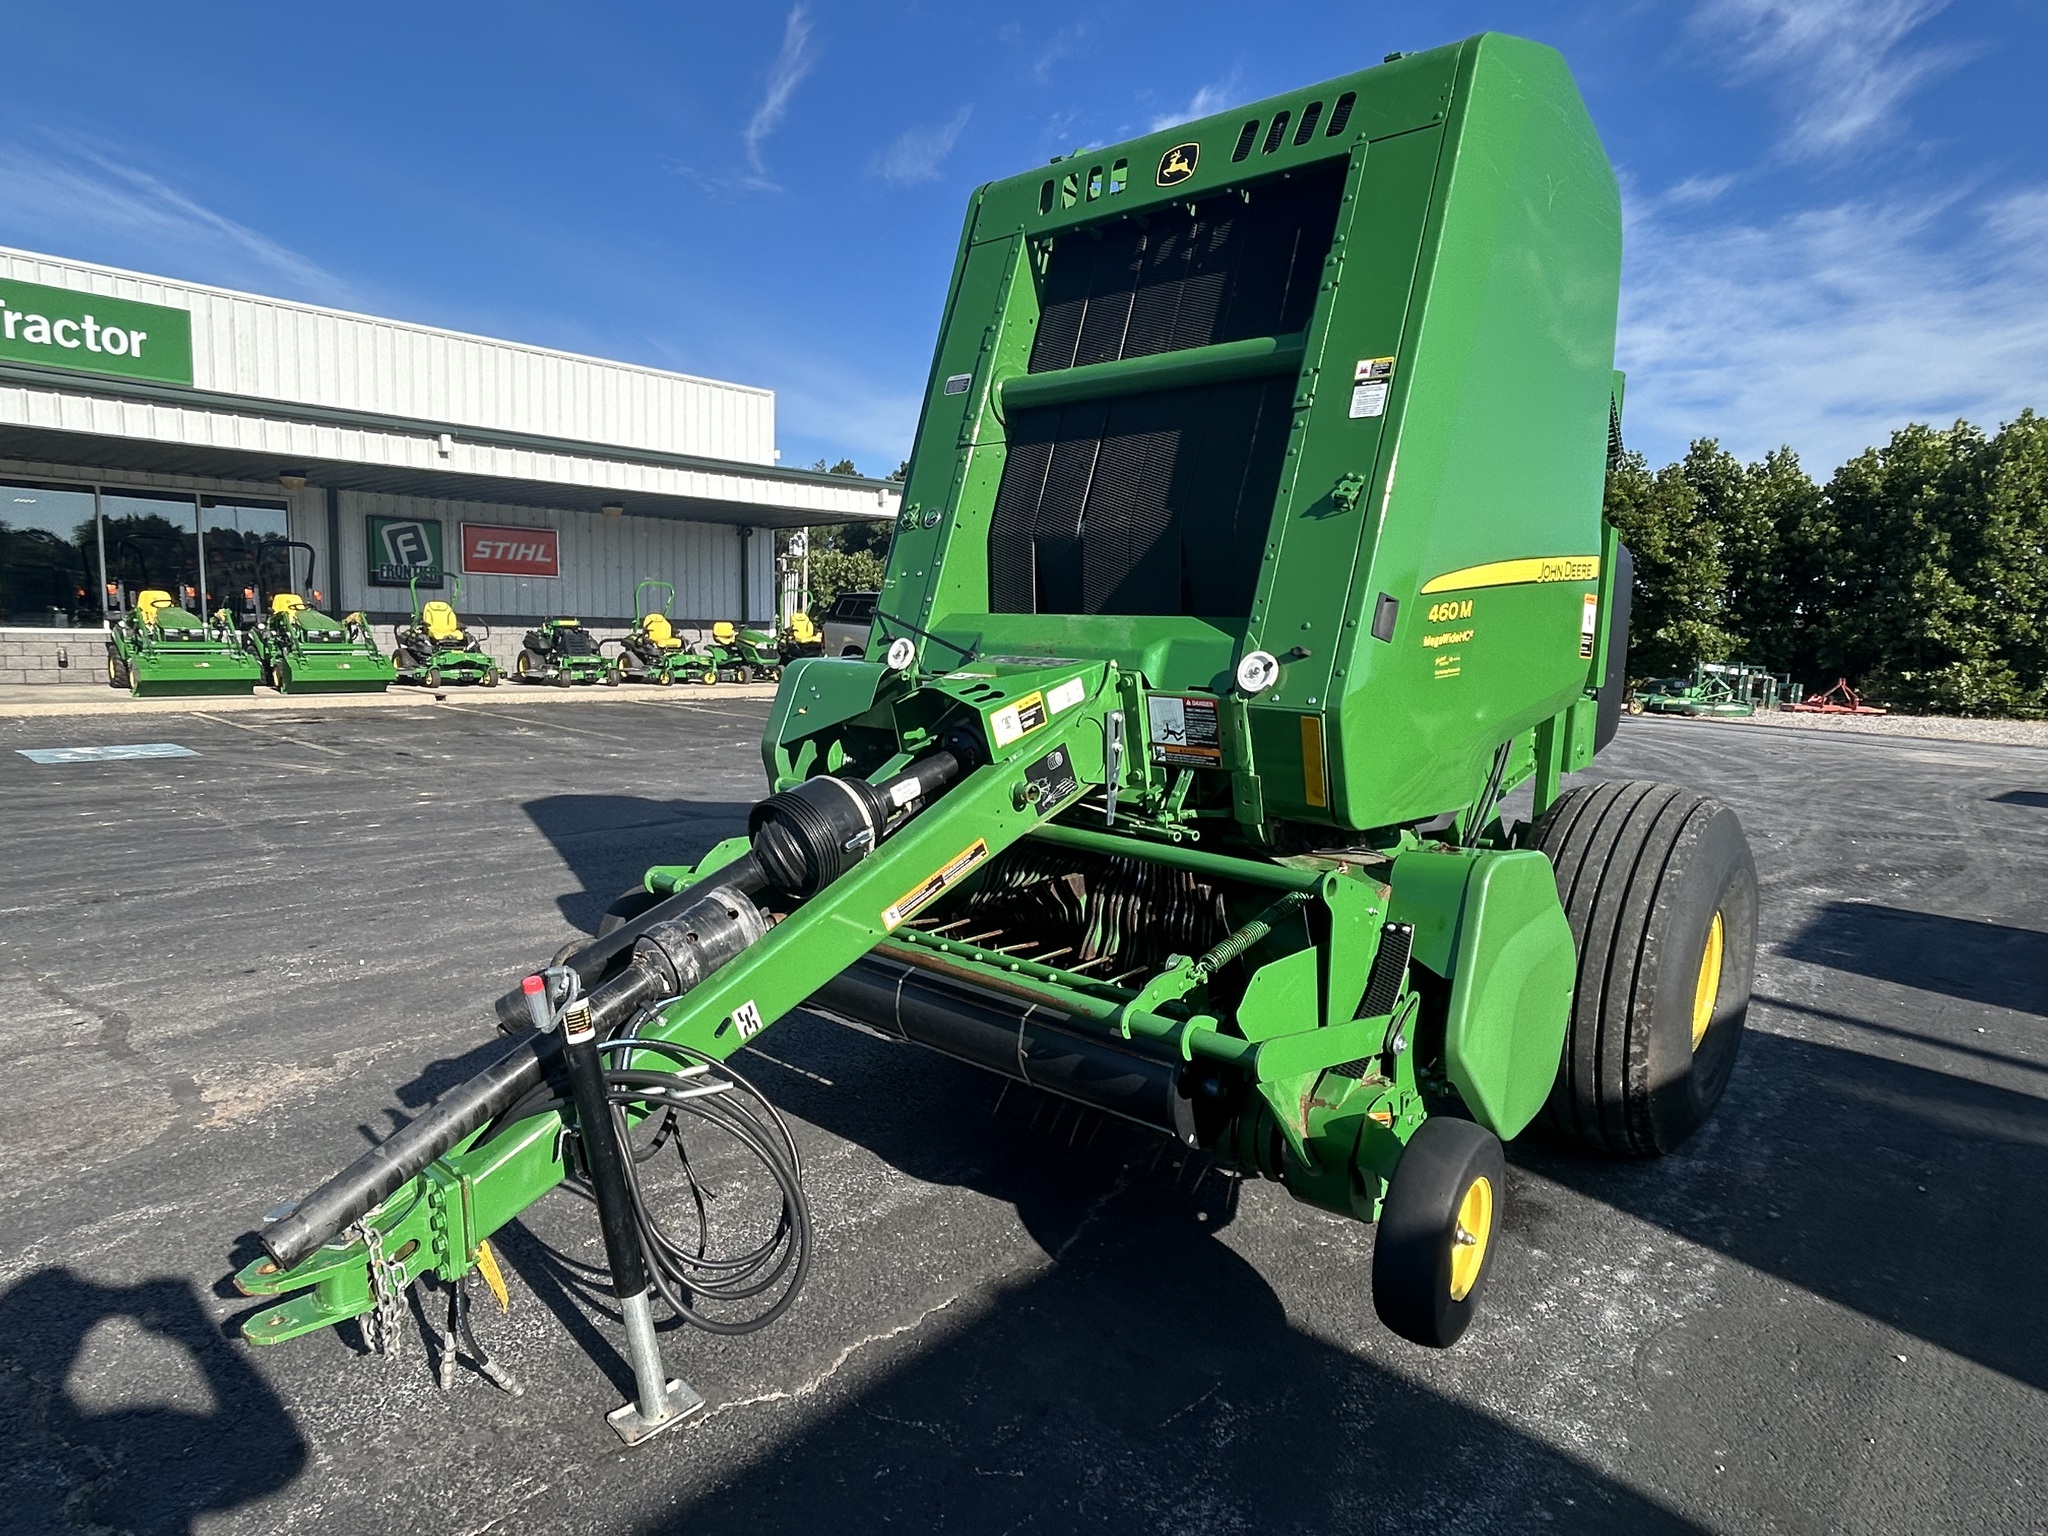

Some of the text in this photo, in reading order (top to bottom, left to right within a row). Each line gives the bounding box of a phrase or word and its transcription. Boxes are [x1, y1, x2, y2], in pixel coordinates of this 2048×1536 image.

[0, 299, 147, 358] ractor
[472, 540, 552, 563] STIHL
[1538, 561, 1592, 580] JOHN DEERE
[1428, 599, 1474, 623] 460 M
